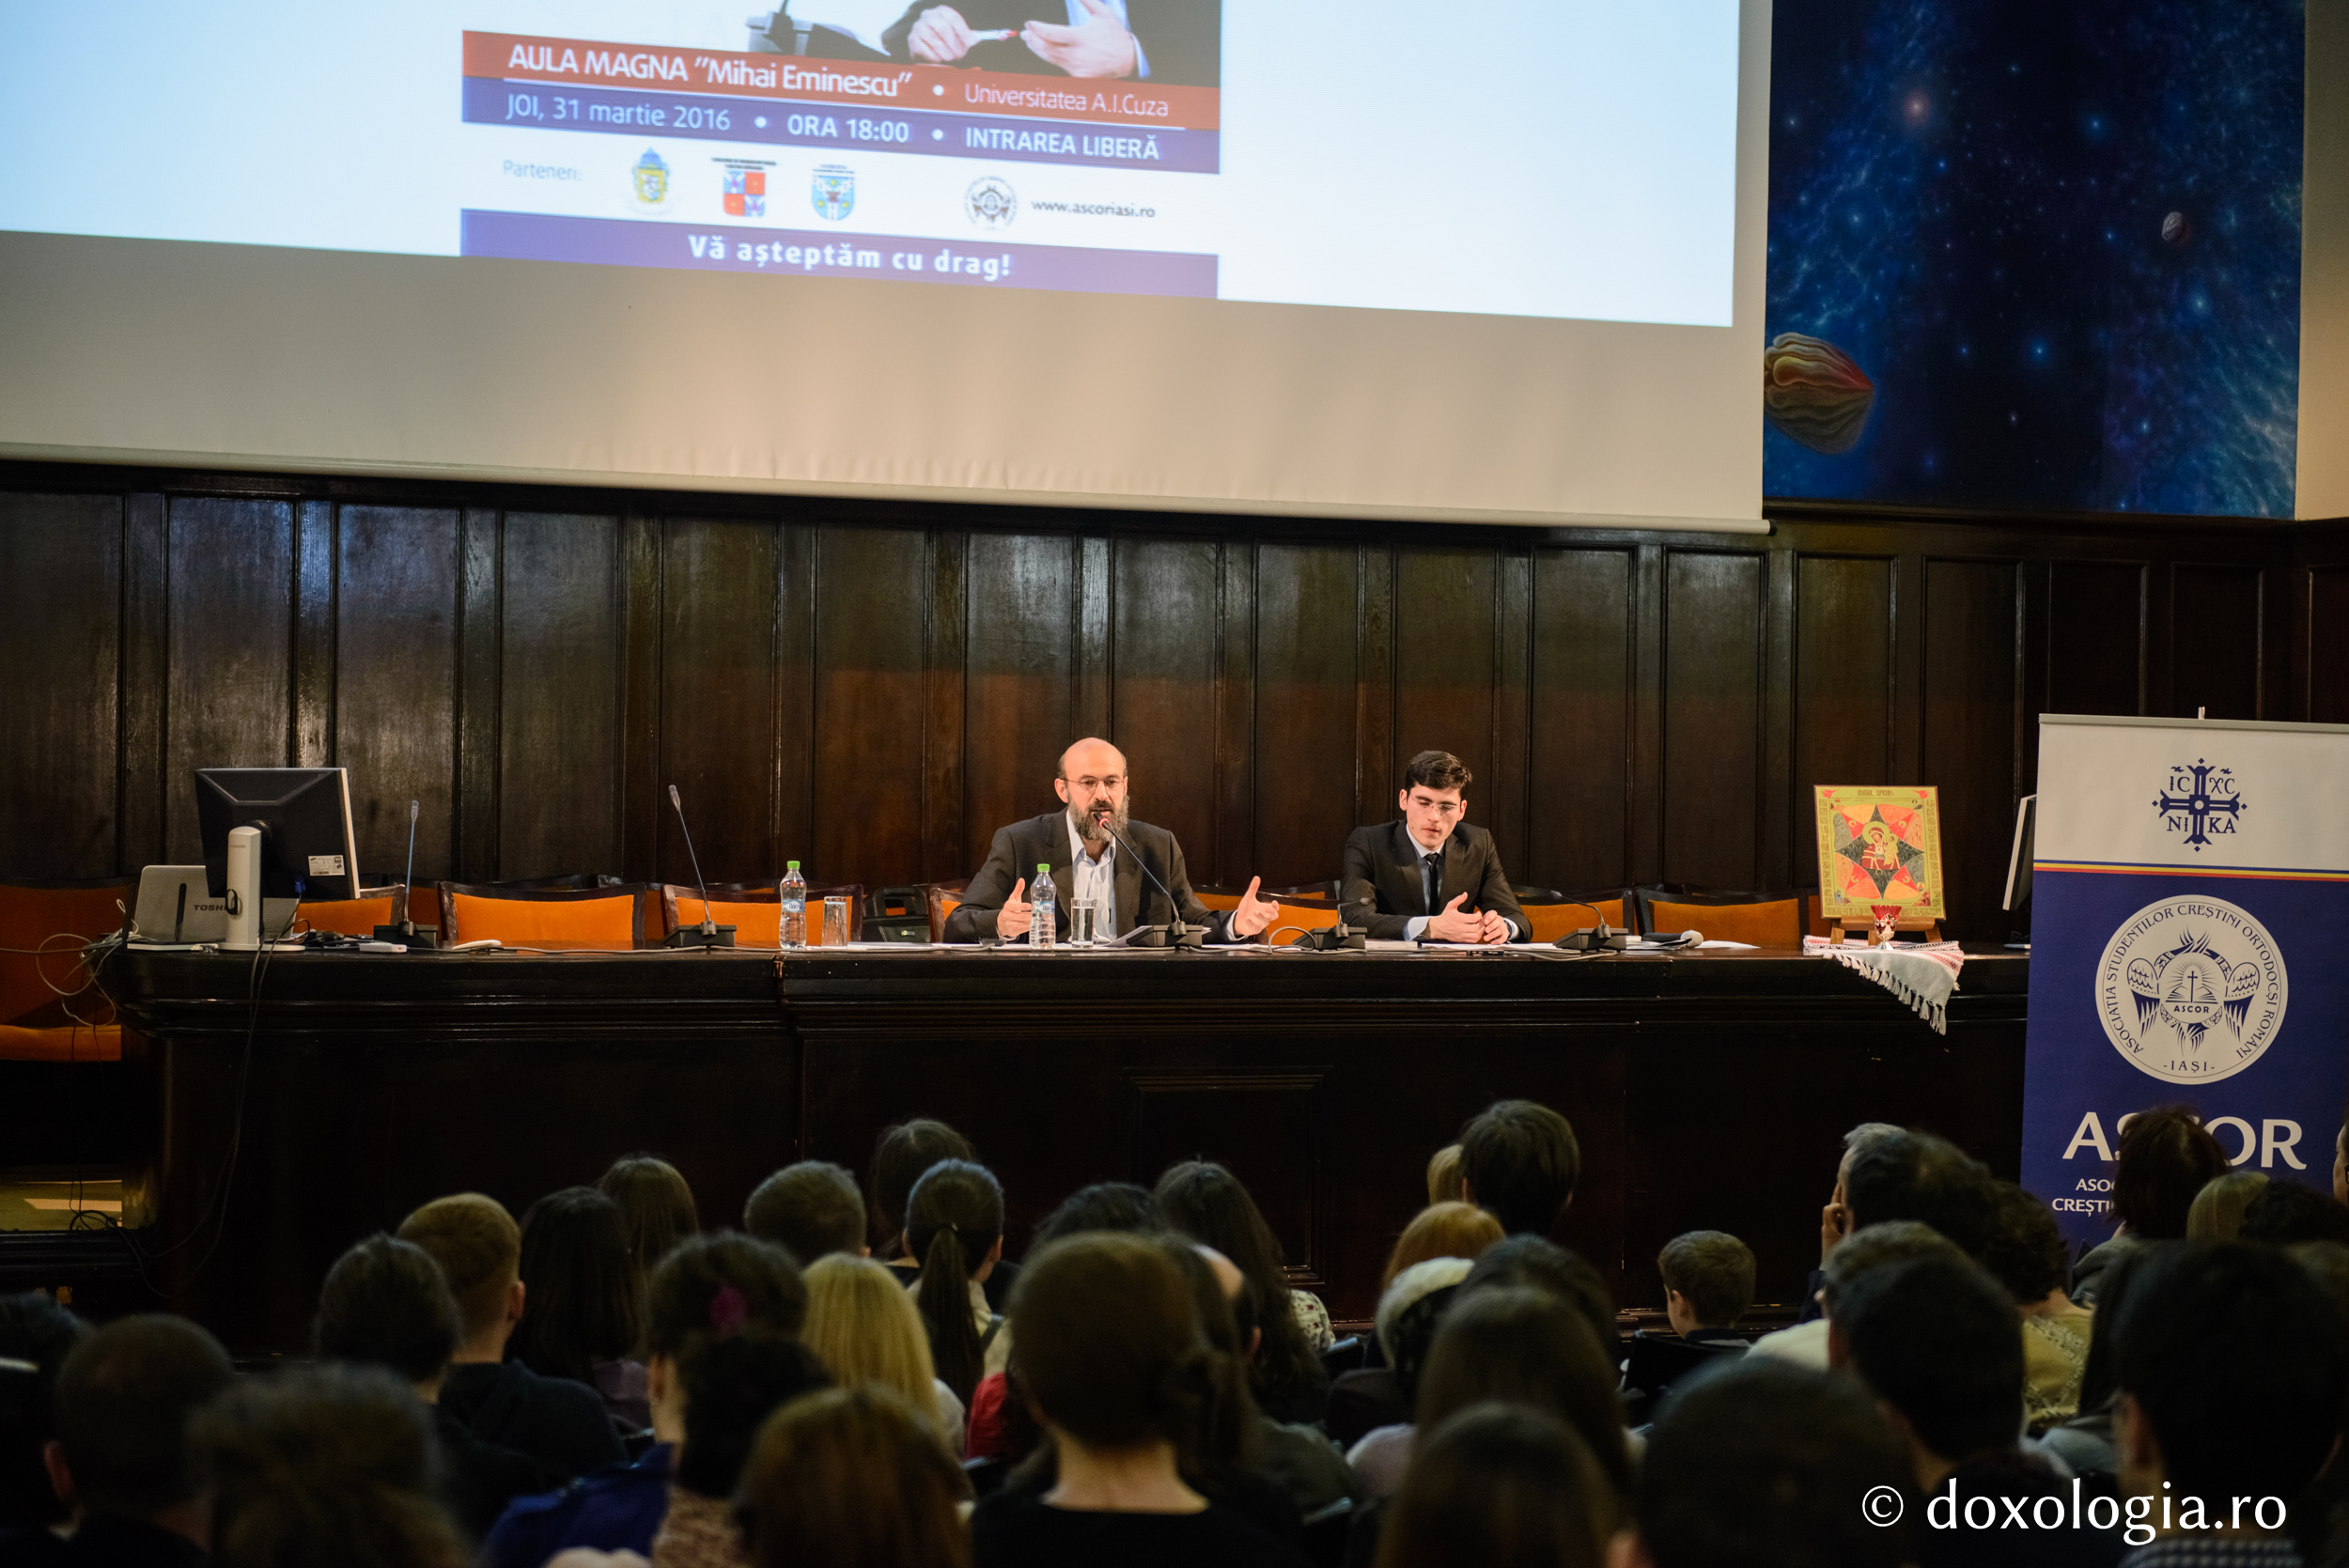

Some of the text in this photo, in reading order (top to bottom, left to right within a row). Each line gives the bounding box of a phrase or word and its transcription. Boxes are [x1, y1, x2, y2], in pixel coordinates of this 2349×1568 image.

[508, 44, 579, 73] AULA
[584, 50, 689, 82] MAGNA
[506, 93, 731, 131] JOI, 31 martie 2016
[965, 83, 1169, 117] Universitatea A.I.Cuza
[787, 114, 910, 143] ORA 18:00
[966, 127, 1159, 160] INTRAREA LIBERĂ
[688, 234, 1010, 282] Vă așteptăm cu drag!
[2177, 904, 2242, 929] CREȘTINI
[2235, 1009, 2276, 1060] ROMÂNI
[2173, 1005, 2210, 1014] ASCOR
[2062, 1111, 2308, 1171] AOR
